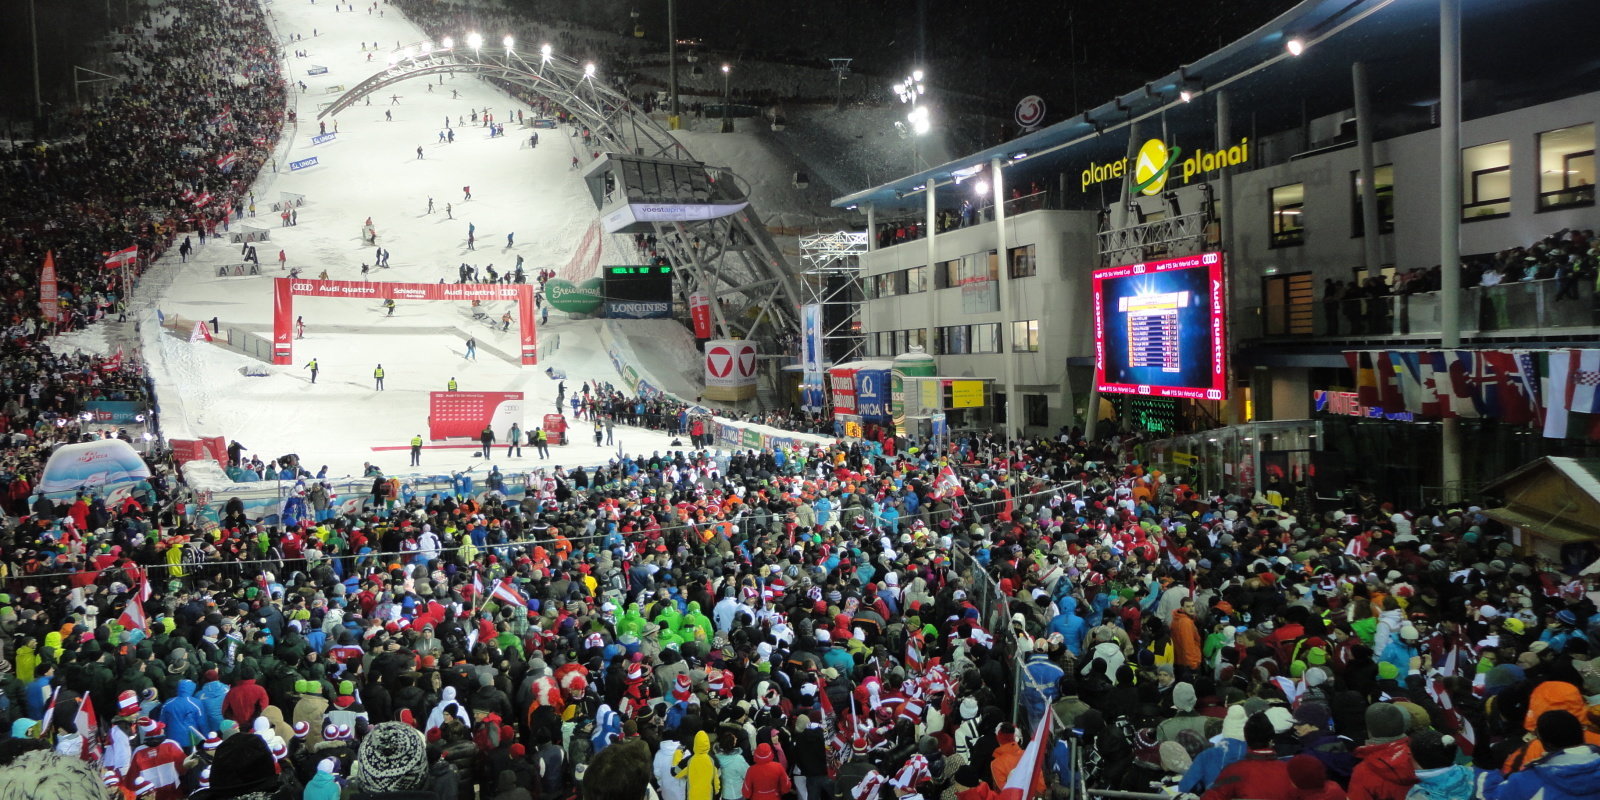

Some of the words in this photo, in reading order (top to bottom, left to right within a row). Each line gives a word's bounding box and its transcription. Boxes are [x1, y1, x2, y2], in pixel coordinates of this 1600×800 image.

[1081, 155, 1128, 193] planet
[1183, 137, 1248, 184] planai
[342, 286, 375, 294] quattro
[611, 302, 668, 313] LONGINES
[1213, 317, 1222, 375] quattro
[859, 403, 881, 416] UNIQA
